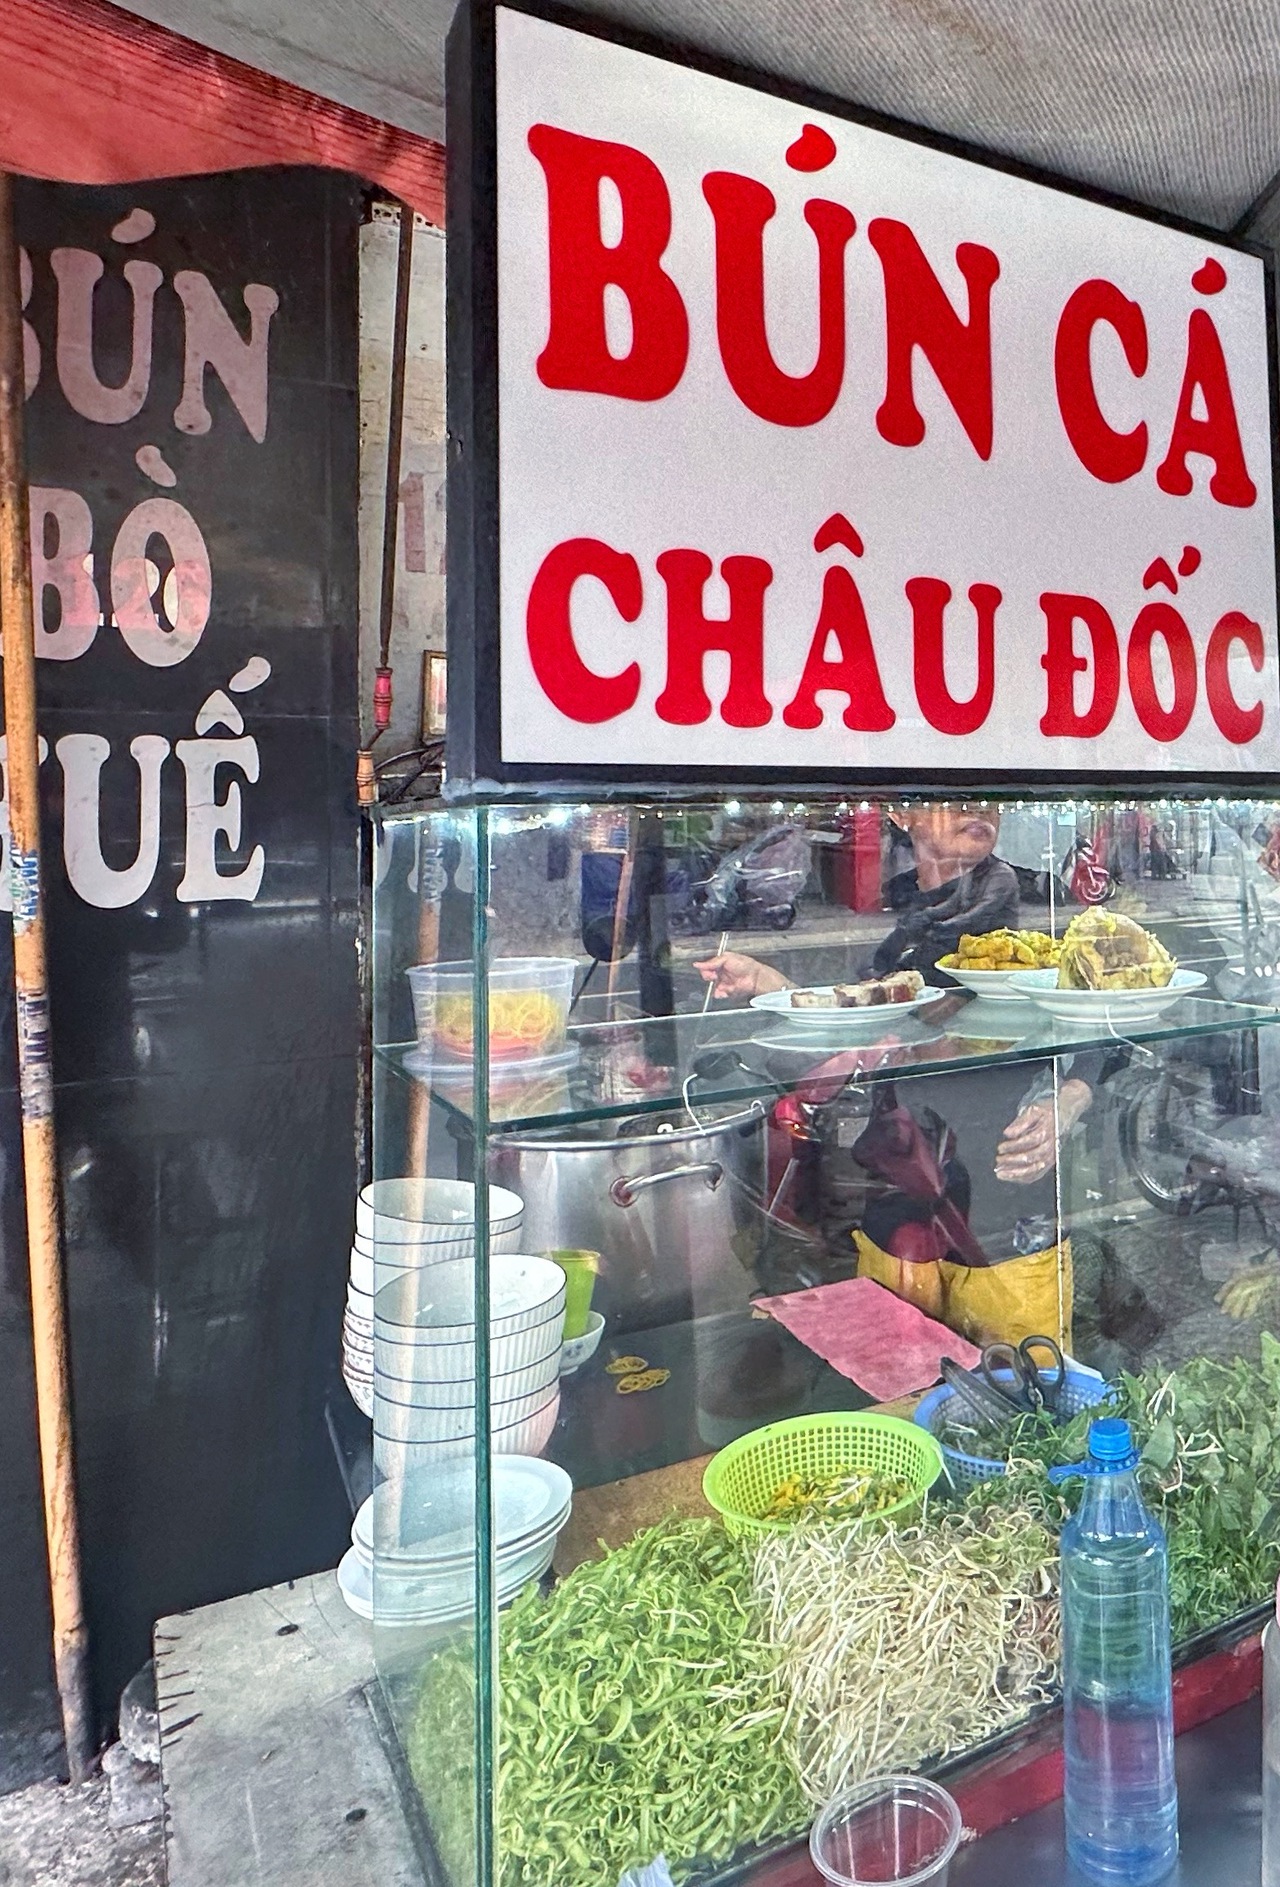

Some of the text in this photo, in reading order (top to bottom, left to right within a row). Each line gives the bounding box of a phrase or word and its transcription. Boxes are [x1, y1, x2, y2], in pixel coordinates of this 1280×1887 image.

[20, 207, 280, 443] ÚN
[526, 123, 1258, 508] BÚN CÁ
[0, 445, 213, 668] BÒ
[525, 513, 1266, 745] CHÂU ĐỐC
